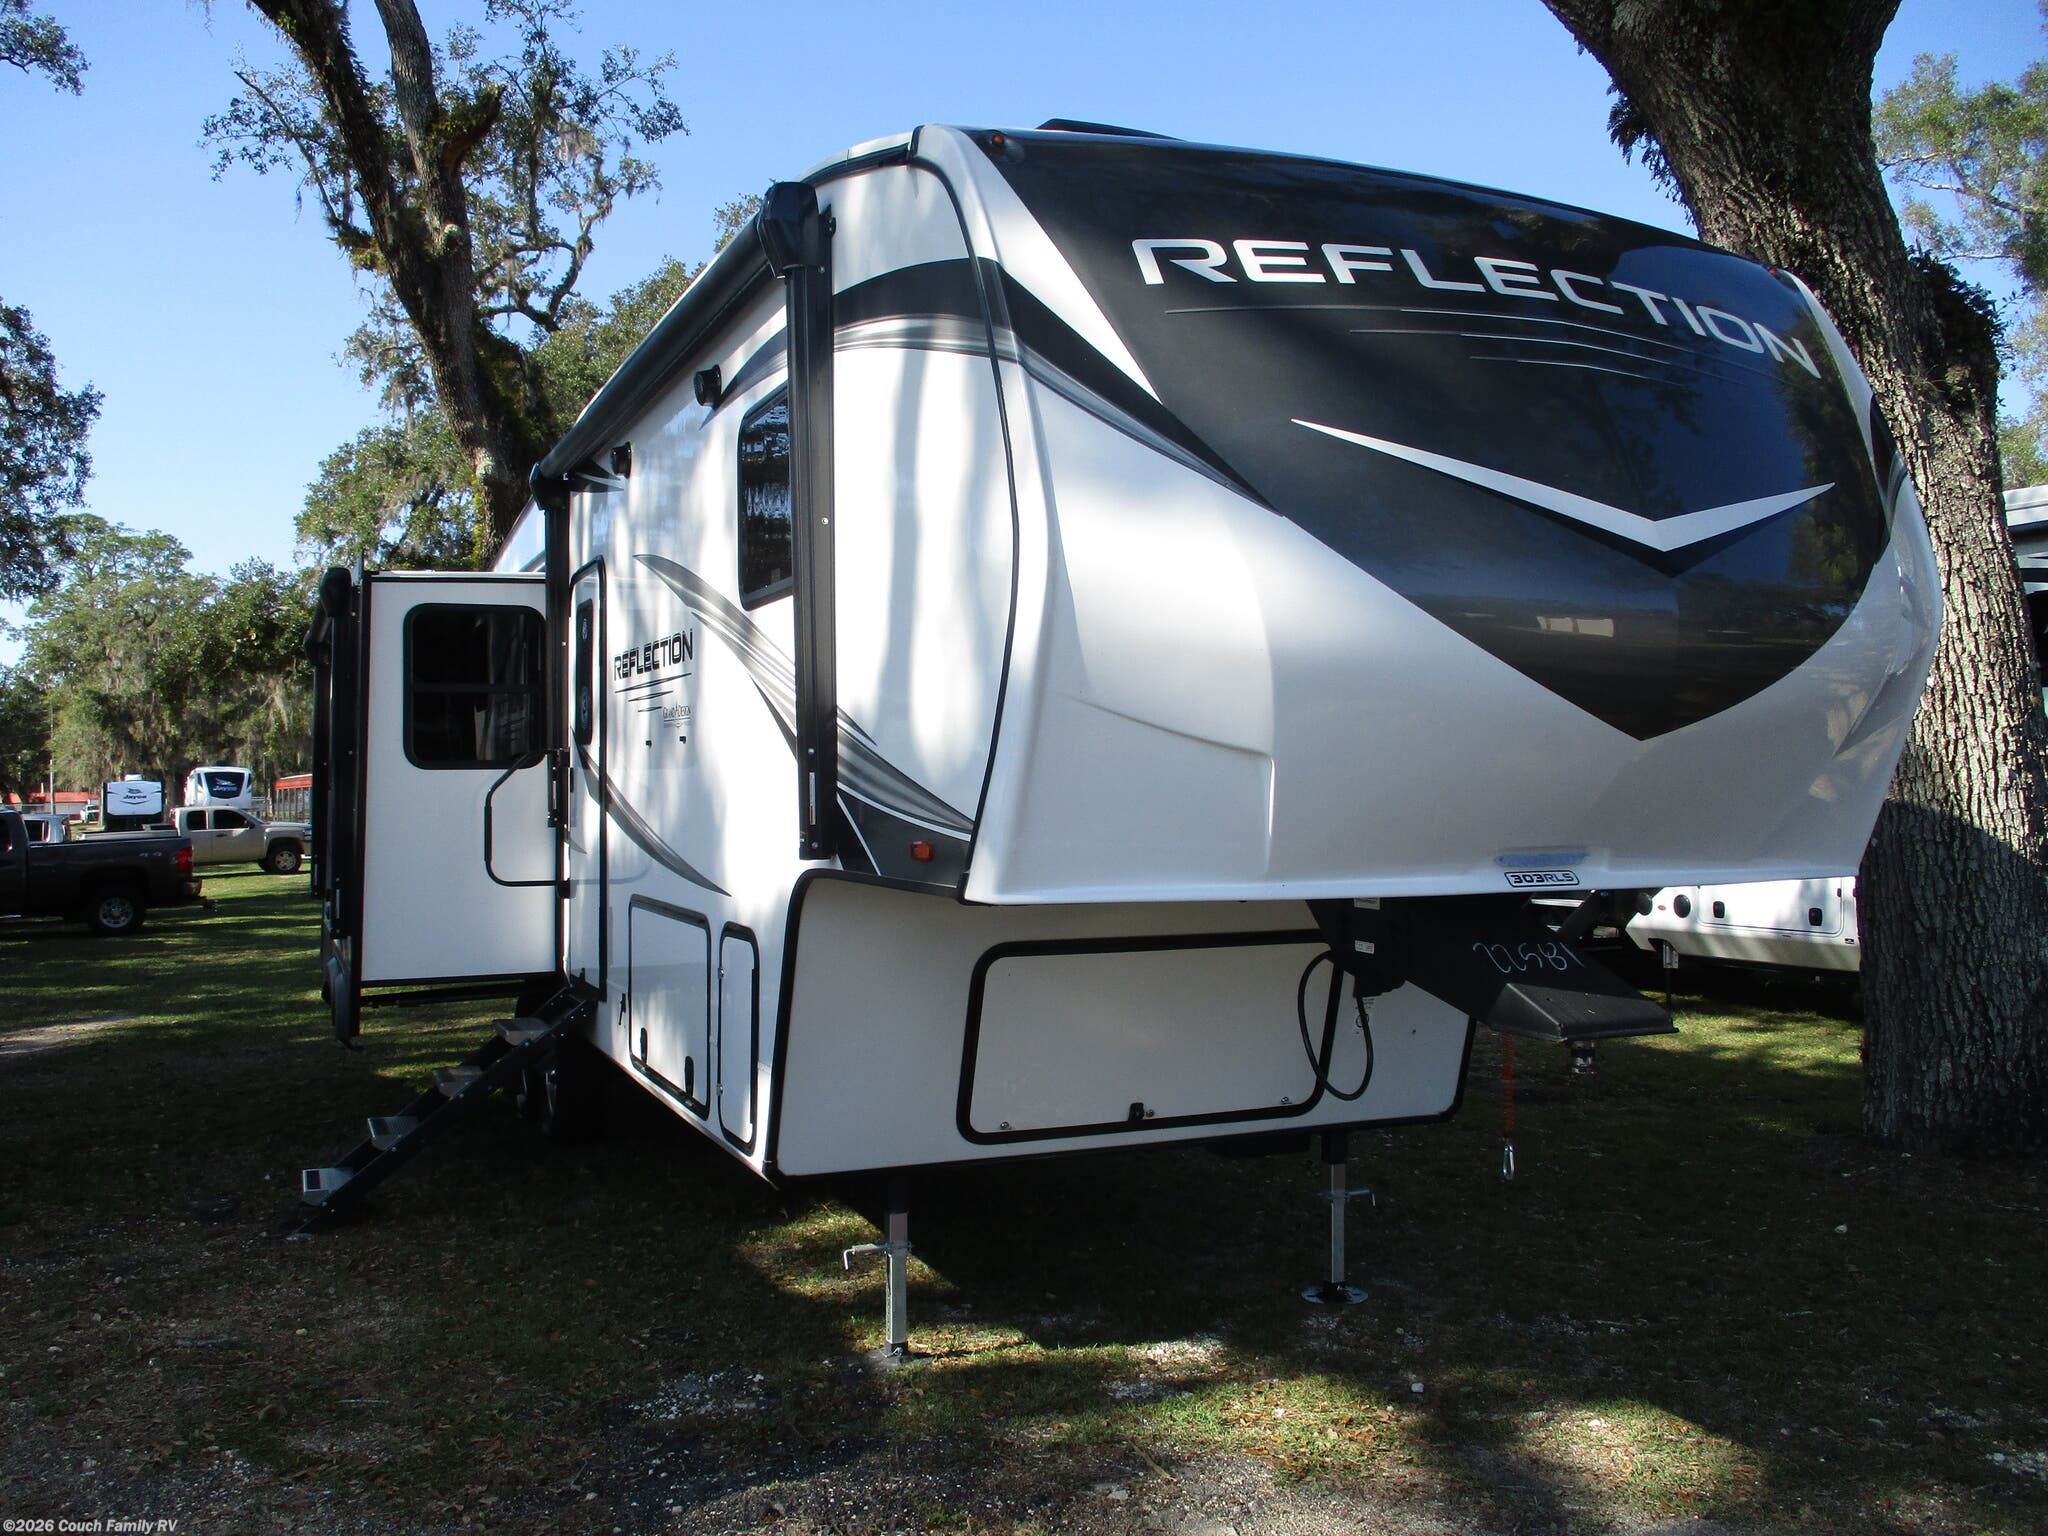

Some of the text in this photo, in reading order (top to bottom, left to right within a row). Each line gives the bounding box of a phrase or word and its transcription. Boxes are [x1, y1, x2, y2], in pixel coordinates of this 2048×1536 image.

[1131, 237, 1822, 380] REFLECTION
[613, 628, 694, 681] REFLECTION
[1510, 872, 1574, 884] 303RLS
[1472, 941, 1585, 974] 22581
